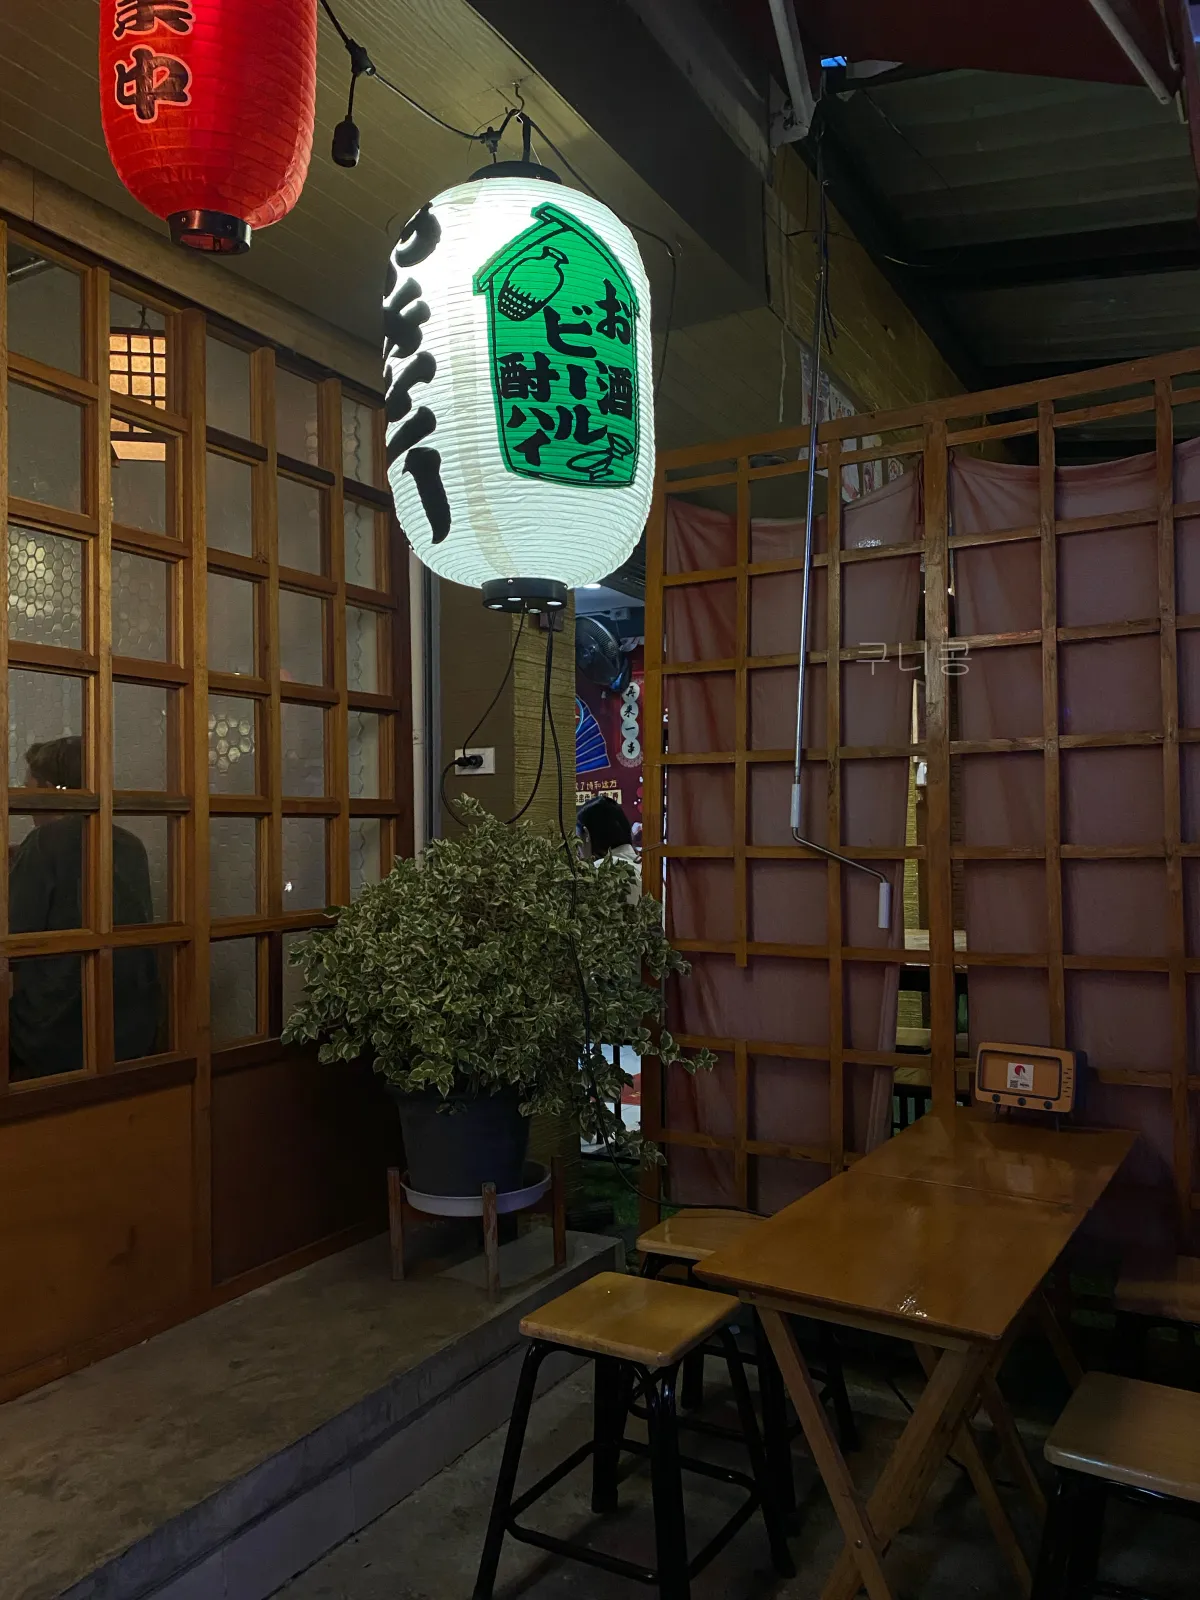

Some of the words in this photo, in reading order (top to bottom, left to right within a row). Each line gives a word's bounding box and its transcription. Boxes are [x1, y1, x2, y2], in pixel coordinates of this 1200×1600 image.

[497, 350, 561, 467] 酎ハイ
[543, 305, 608, 446] ビール
[595, 278, 632, 420] お酒
